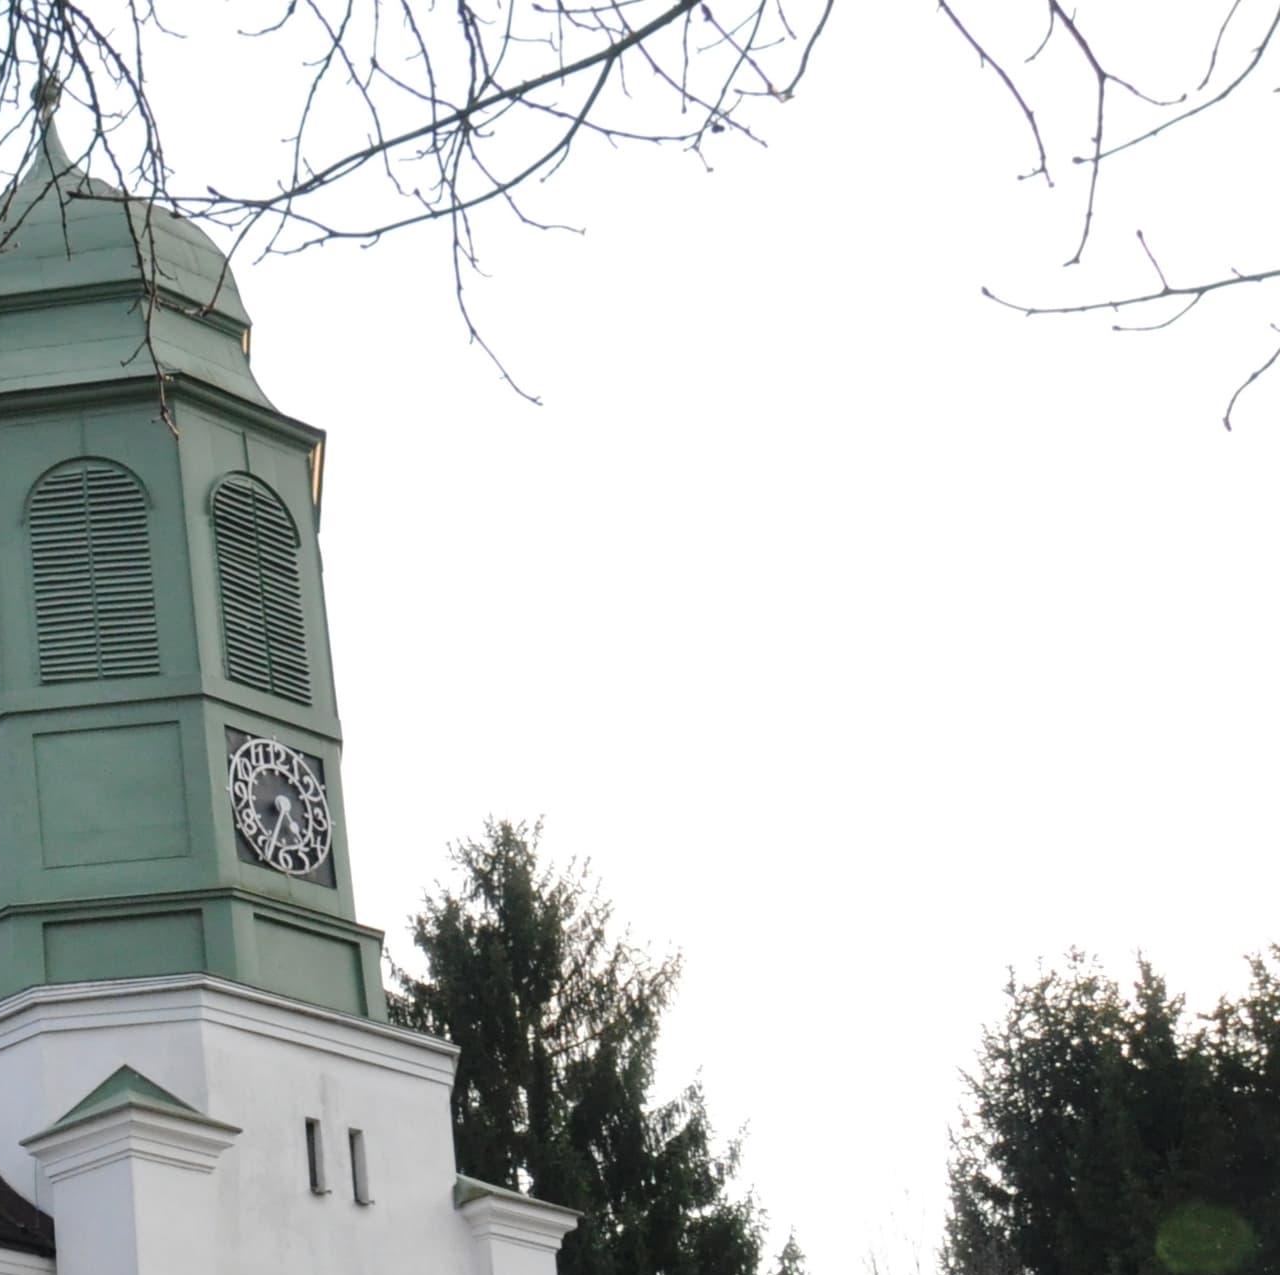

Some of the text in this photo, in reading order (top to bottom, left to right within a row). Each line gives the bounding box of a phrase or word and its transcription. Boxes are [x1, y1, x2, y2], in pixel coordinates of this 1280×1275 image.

[266, 743, 289, 770] 12
[237, 758, 252, 780] 10
[303, 776, 321, 802] 2
[242, 809, 257, 834] 8
[313, 807, 327, 831] 3
[279, 848, 293, 871] 6
